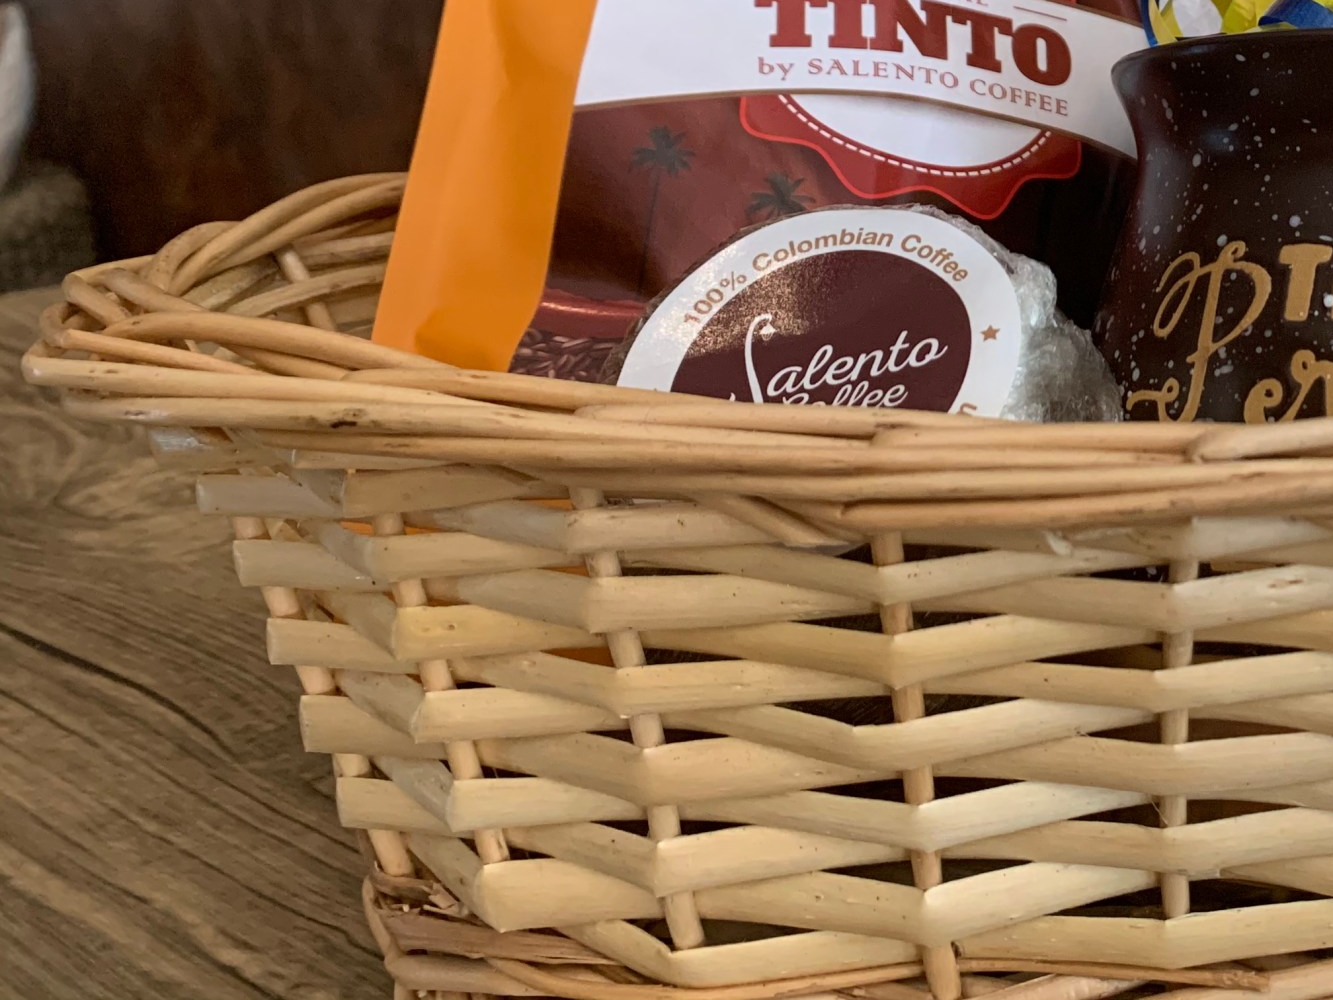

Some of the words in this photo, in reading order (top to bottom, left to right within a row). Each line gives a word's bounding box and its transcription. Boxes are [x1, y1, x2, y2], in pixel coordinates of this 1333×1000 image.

[757, 57, 794, 81] by
[808, 58, 959, 89] SALENTO
[969, 79, 1069, 117] COFFEE
[684, 271, 747, 323] 100%
[752, 227, 894, 271] Colombian
[900, 234, 969, 282] Coffee
